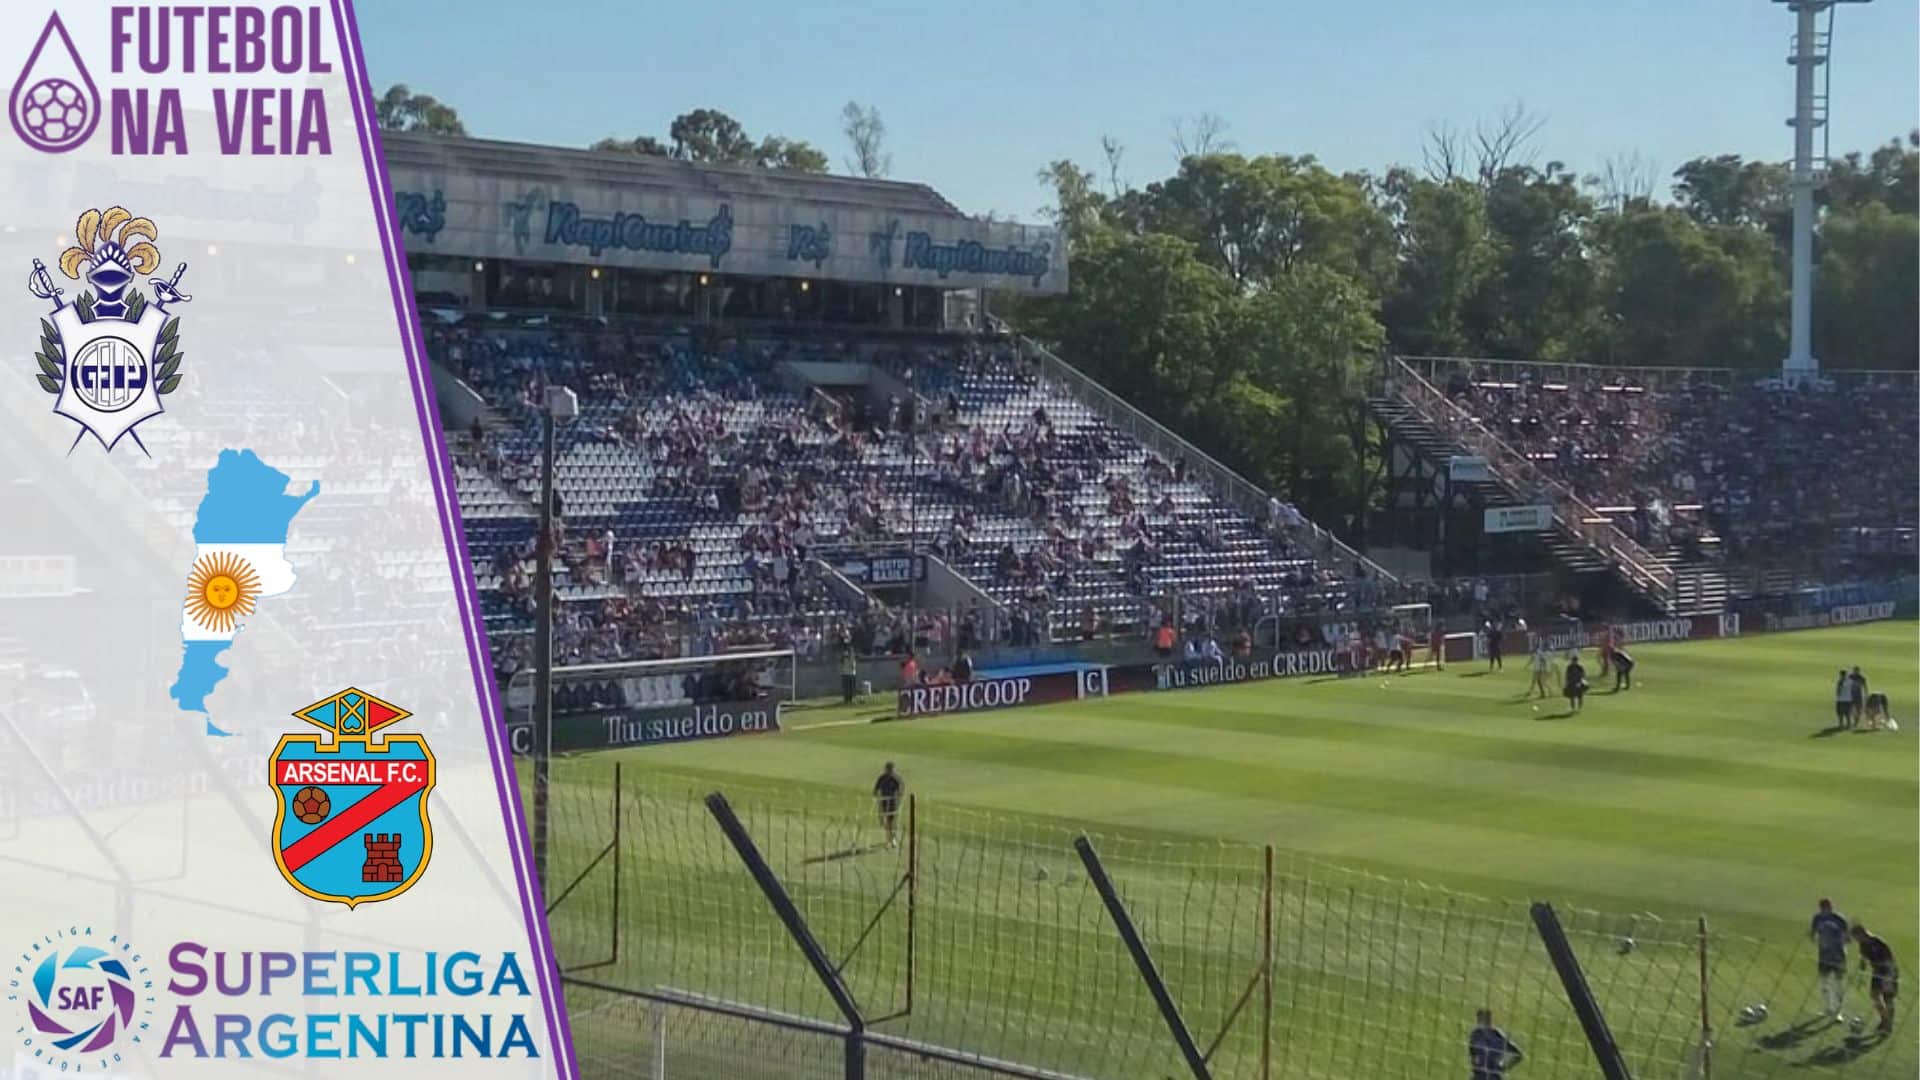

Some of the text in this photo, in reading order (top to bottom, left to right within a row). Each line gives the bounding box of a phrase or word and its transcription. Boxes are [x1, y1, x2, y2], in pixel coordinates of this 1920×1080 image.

[1087, 671, 1100, 693] C
[1191, 656, 1246, 685] sueldo
[1250, 660, 1269, 677] en
[741, 710, 768, 731] en
[512, 727, 530, 753] C
